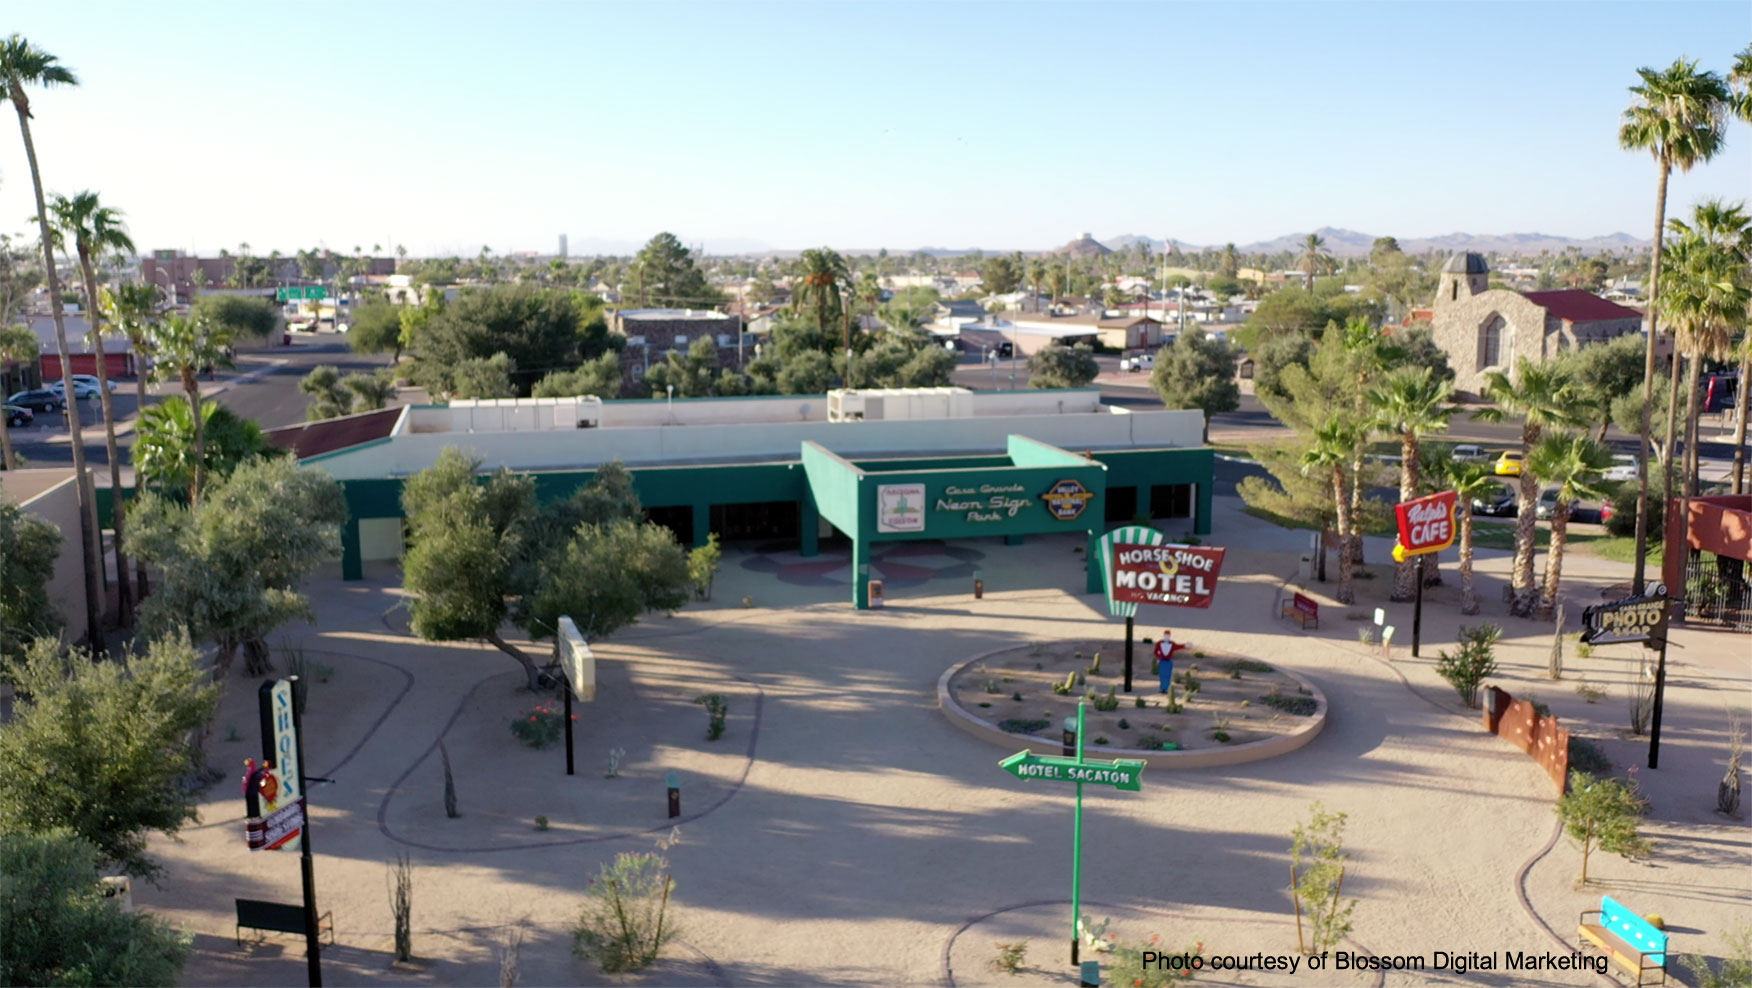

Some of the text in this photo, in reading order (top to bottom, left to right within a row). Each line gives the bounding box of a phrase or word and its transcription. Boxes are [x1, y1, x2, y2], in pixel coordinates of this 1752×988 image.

[945, 484, 1025, 495] Casa Grande
[936, 496, 1033, 517] Neon Sign
[966, 511, 1002, 522] Park
[1410, 520, 1449, 545] CAFE
[1119, 548, 1214, 572] HORSE SHOE
[1116, 570, 1210, 595] MOTEL
[1602, 609, 1661, 628] PHOTO
[277, 689, 294, 798] SHOES
[1018, 764, 1130, 784] HOTEL SACATON
